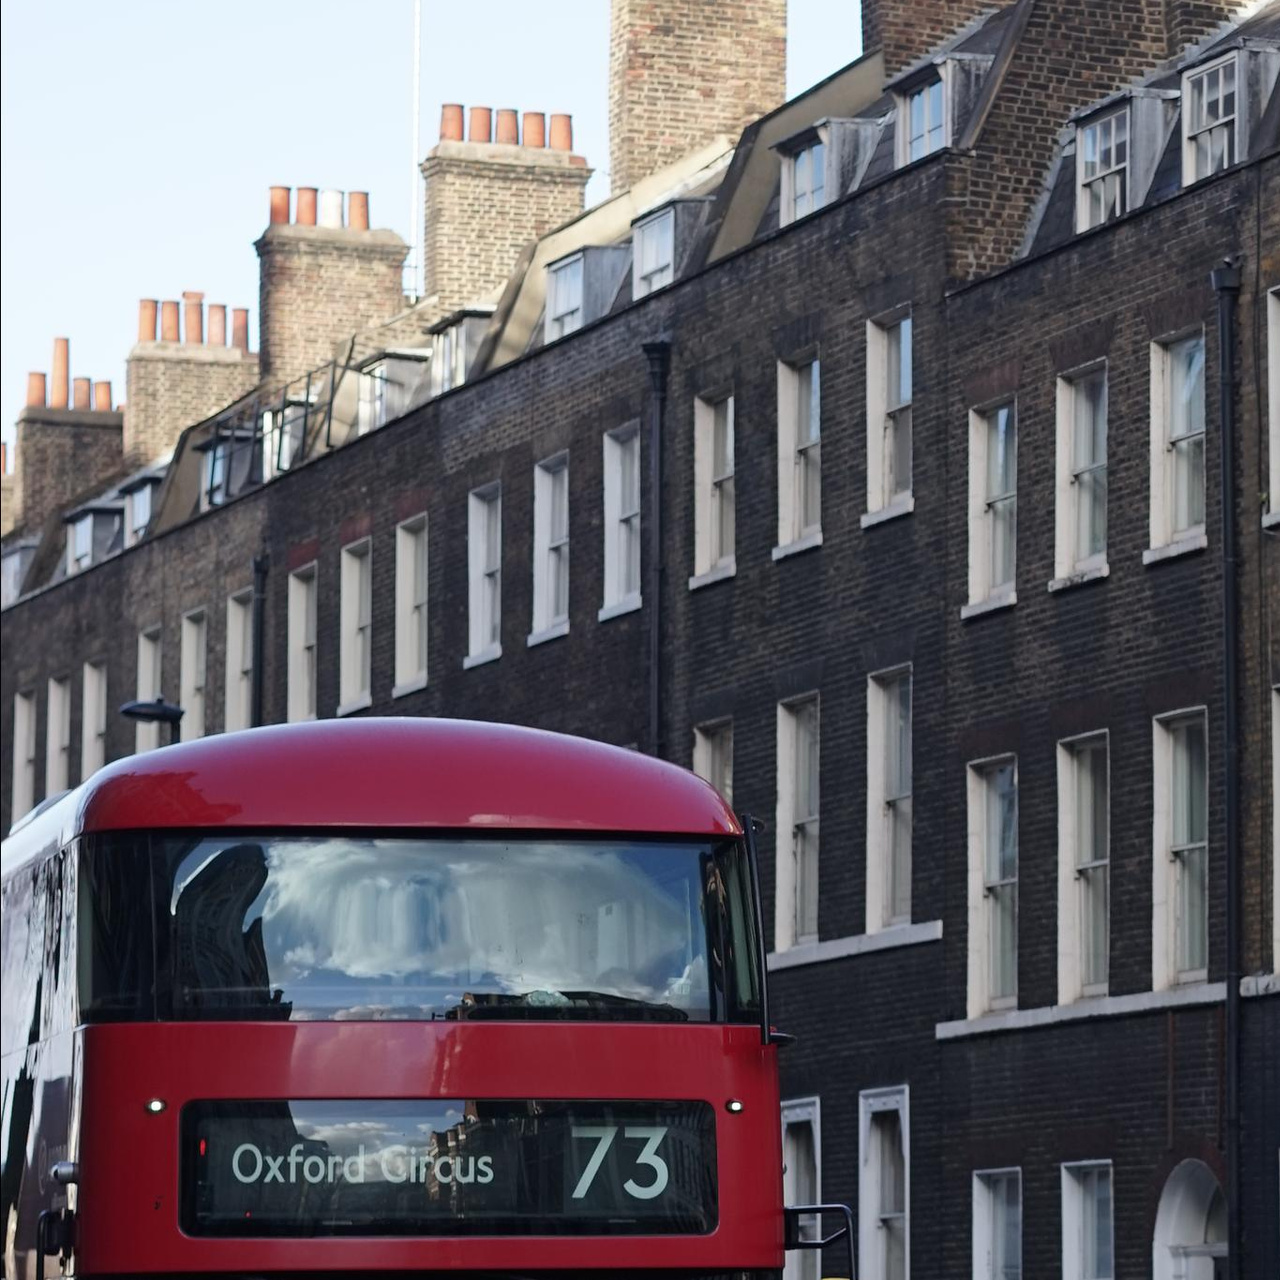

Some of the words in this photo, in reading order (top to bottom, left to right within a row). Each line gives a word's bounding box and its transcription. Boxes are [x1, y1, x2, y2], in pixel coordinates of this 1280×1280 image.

[232, 1142, 365, 1185] Oxford
[380, 1142, 495, 1185] Circus
[571, 1126, 669, 1200] 73
